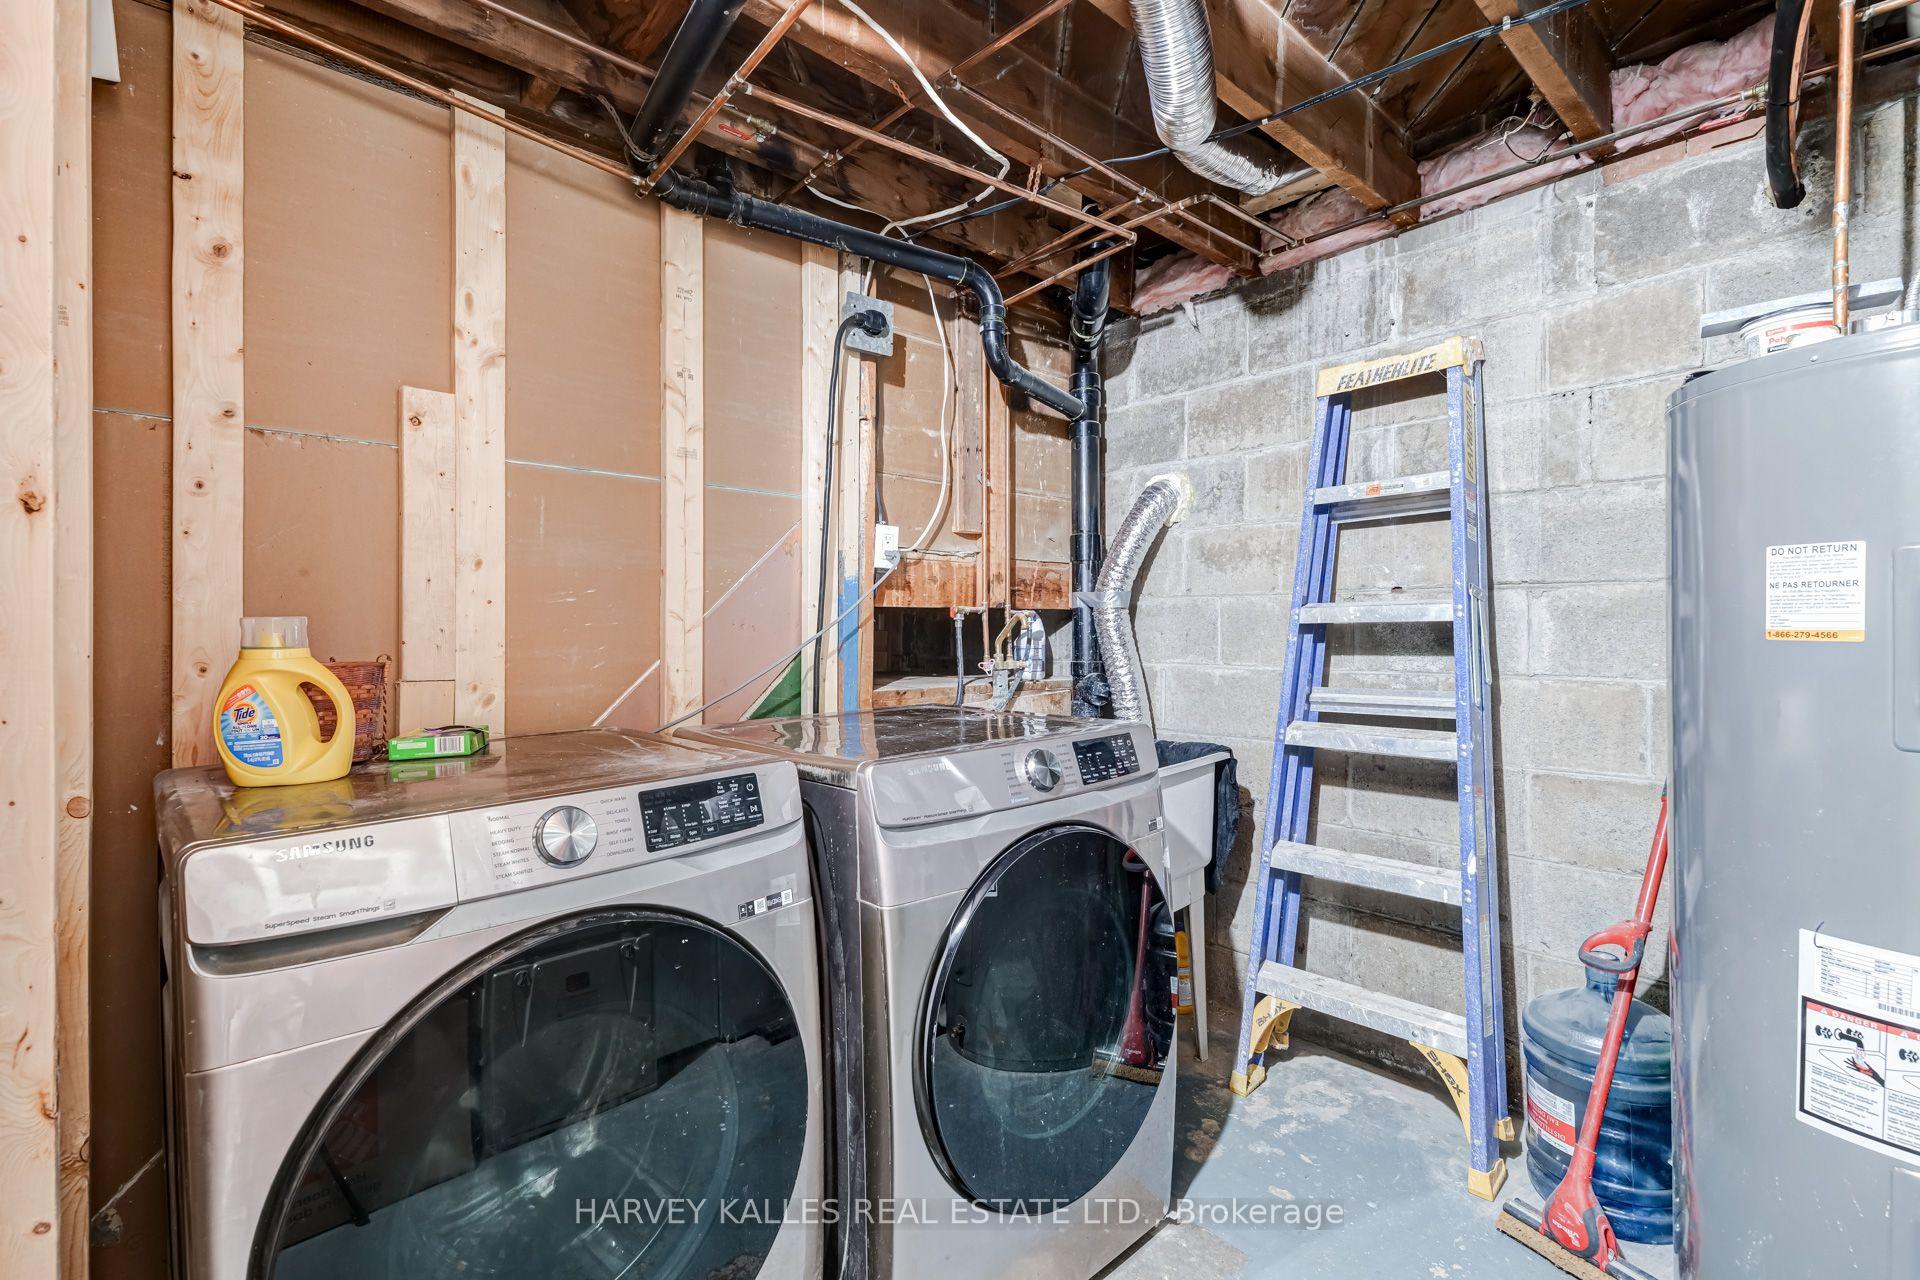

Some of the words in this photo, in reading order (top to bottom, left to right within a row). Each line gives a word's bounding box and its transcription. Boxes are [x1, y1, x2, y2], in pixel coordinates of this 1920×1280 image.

[1336, 353, 1438, 391] FEATHERLITE
[1771, 547, 1785, 556] DO
[1787, 546, 1808, 555] NOT
[1811, 543, 1858, 554] RETURN
[1769, 581, 1780, 589] NE
[1782, 581, 1799, 589] PAS
[1800, 579, 1860, 588] RETOURNER
[1767, 631, 1839, 639] 1-866-279-4566
[234, 706, 256, 722] Tide
[508, 825, 521, 833] DUTY
[275, 835, 375, 863] SAMSUNG
[493, 850, 510, 858] STEAM
[512, 857, 530, 865] WHITES
[496, 872, 512, 880] STEAM
[513, 868, 534, 876] SANITIZE
[264, 916, 310, 930] SuperSpeed
[312, 913, 336, 922] Steam
[339, 904, 380, 918] SmartThings
[1831, 1009, 1879, 1030] DANGER
